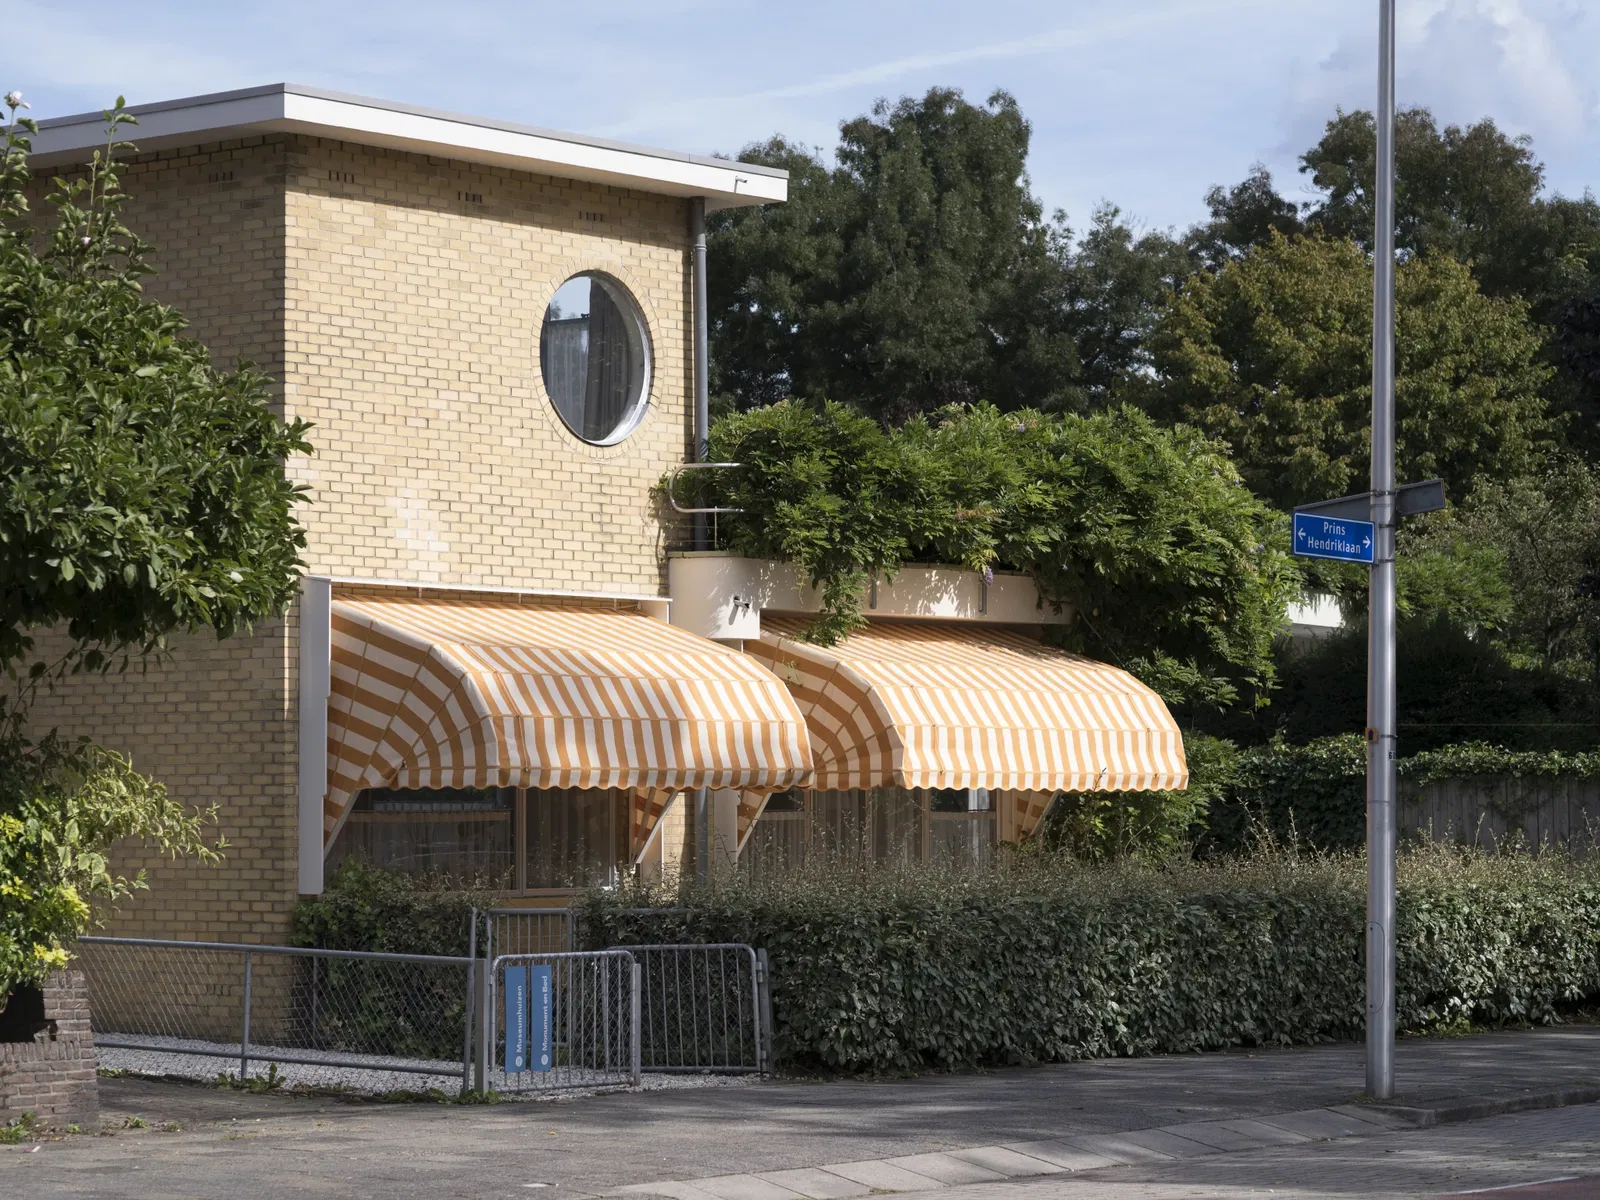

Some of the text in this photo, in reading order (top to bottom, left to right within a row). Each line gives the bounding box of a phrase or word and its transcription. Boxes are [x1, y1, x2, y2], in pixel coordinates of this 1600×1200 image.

[1323, 521, 1346, 535] Prins
[1308, 536, 1361, 554] Hendriklaan
[543, 994, 548, 1004] en
